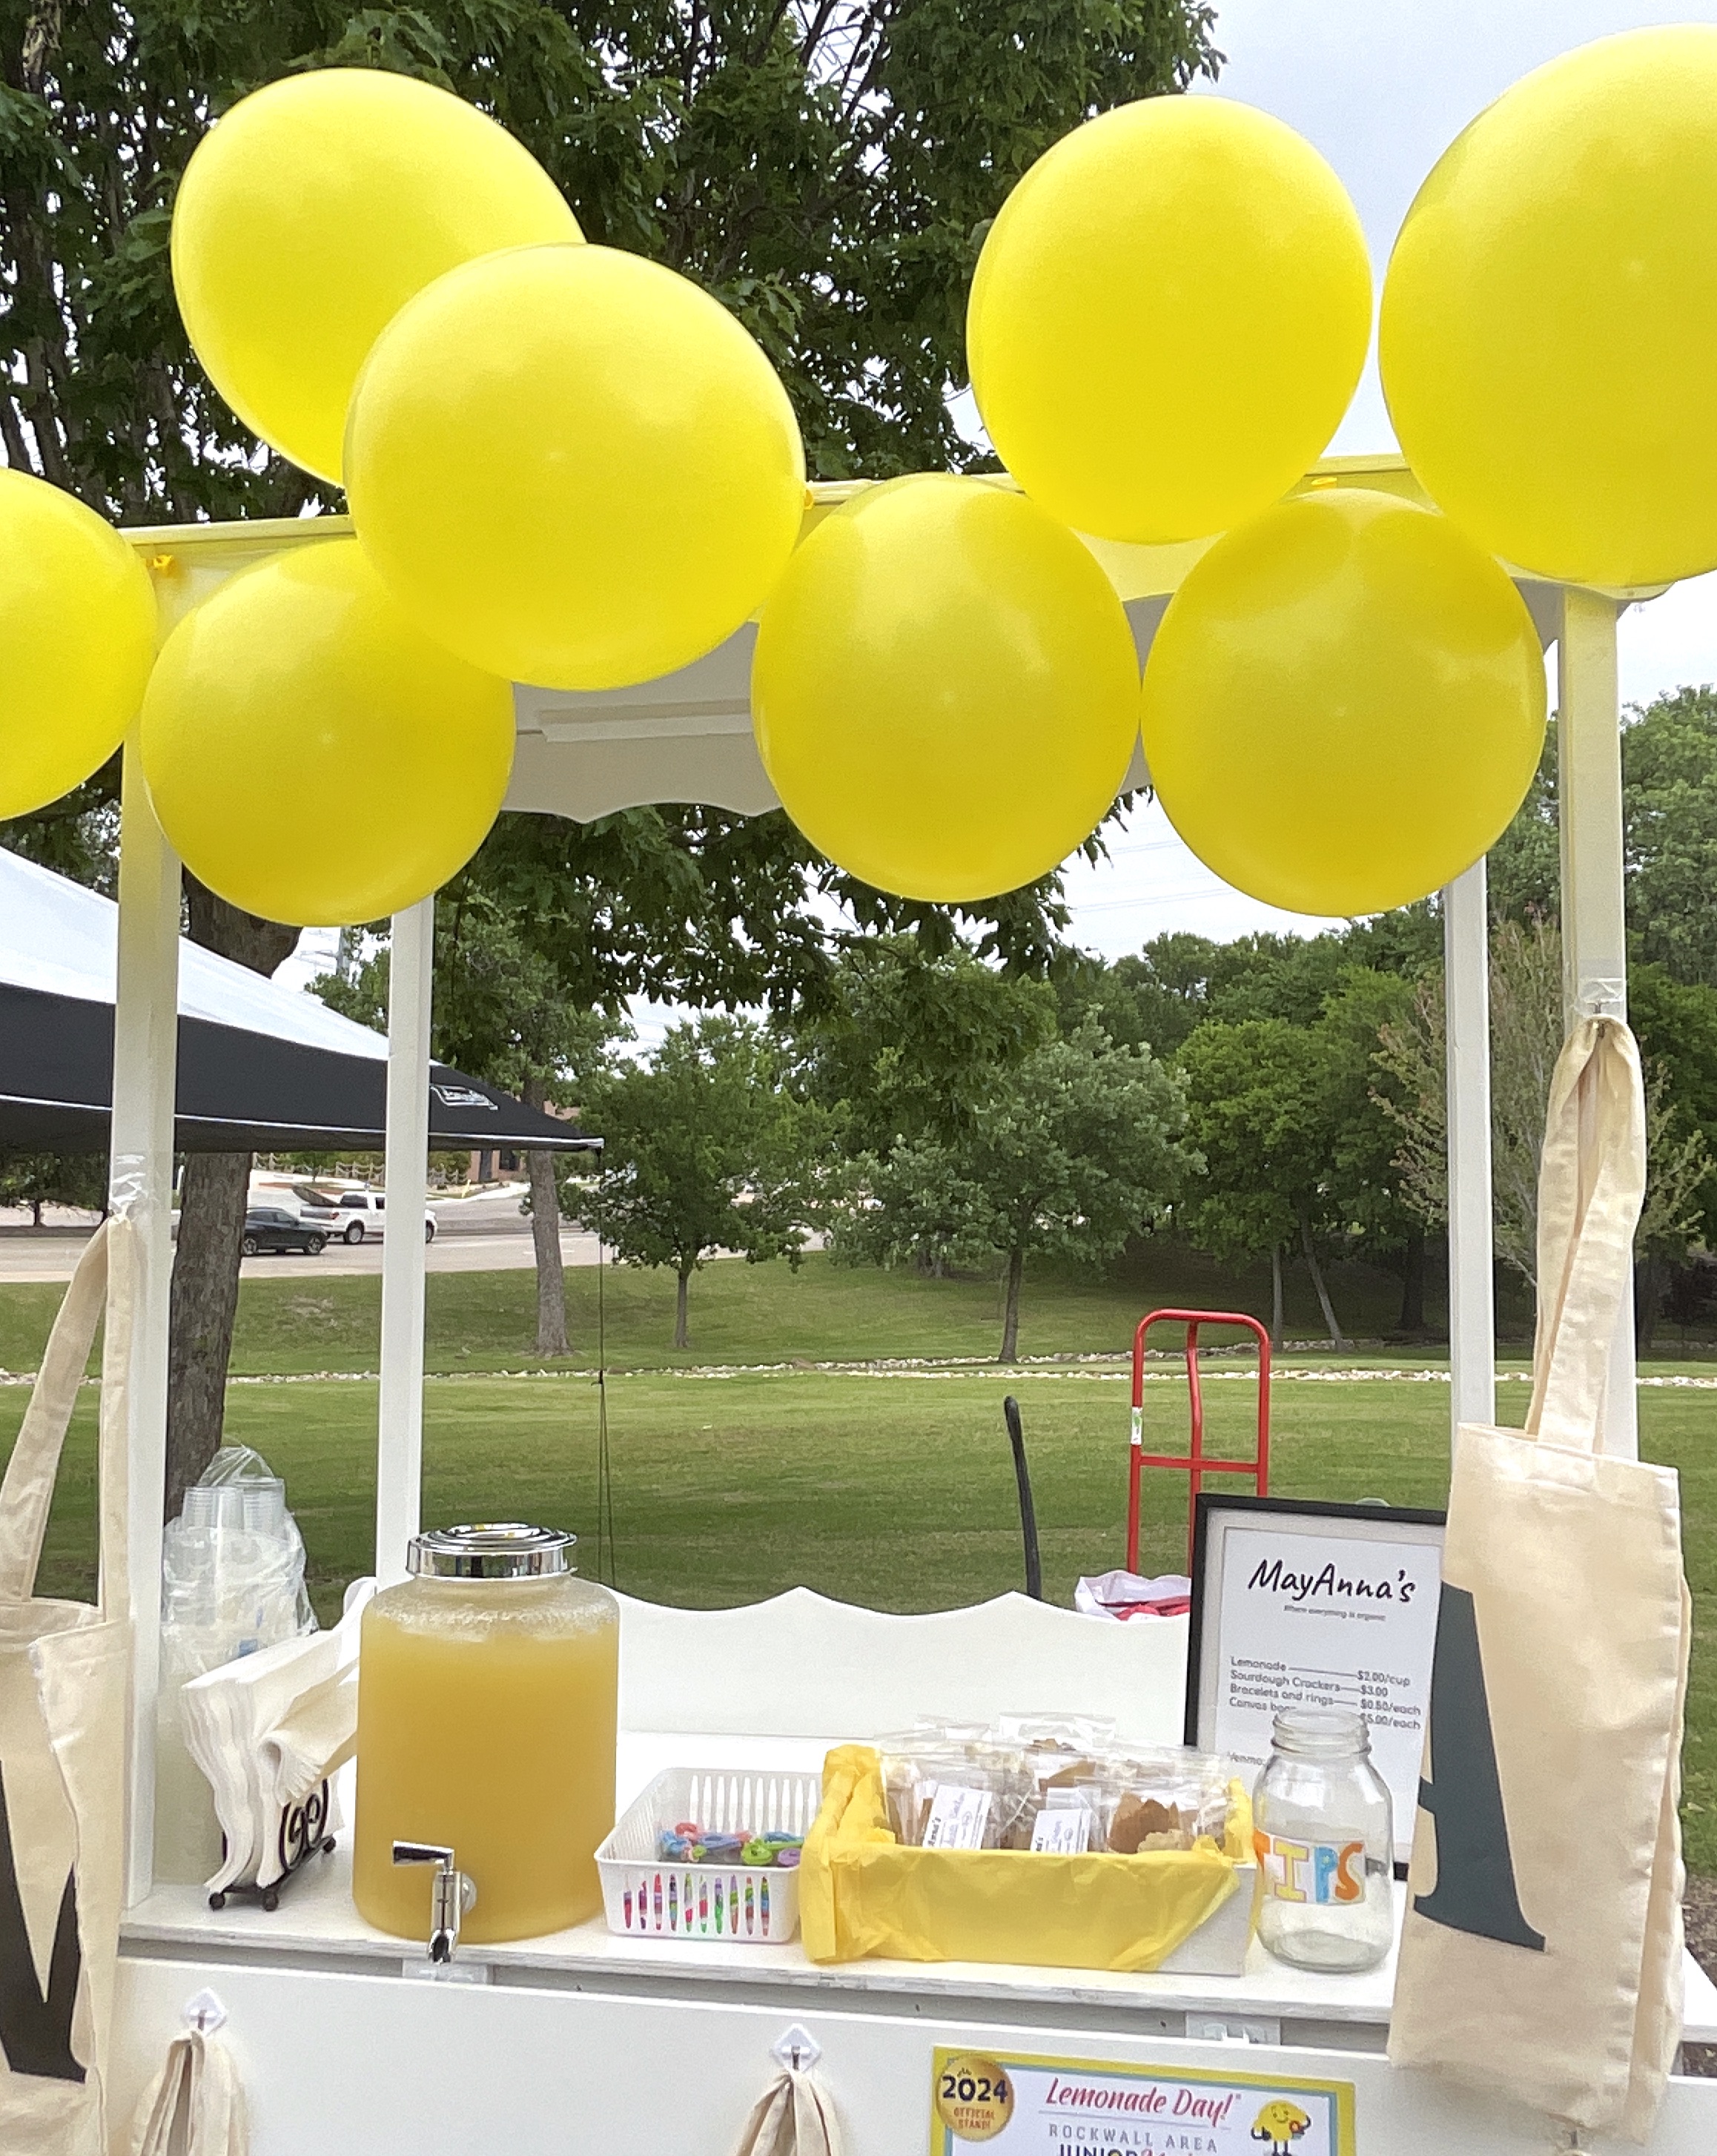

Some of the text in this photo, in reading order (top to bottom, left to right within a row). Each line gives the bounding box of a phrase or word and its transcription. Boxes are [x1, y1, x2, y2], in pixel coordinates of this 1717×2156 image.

[1248, 1559, 1415, 1602] MayAnna's
[1230, 1656, 1410, 1687] Lemonade $2.00/cup
[1231, 1670, 1388, 1697] Sourdough Crackers $3.00
[1230, 1683, 1421, 1716] Bracelets and rings $0.50/each
[1230, 1696, 1267, 1710] Canvas
[942, 2074, 1008, 2104] 2024
[1045, 2077, 1234, 2128] Lemonade Day!
[953, 2107, 995, 2120] OFFICIAL
[1048, 2123, 1217, 2154] ROCKWALL AREA
